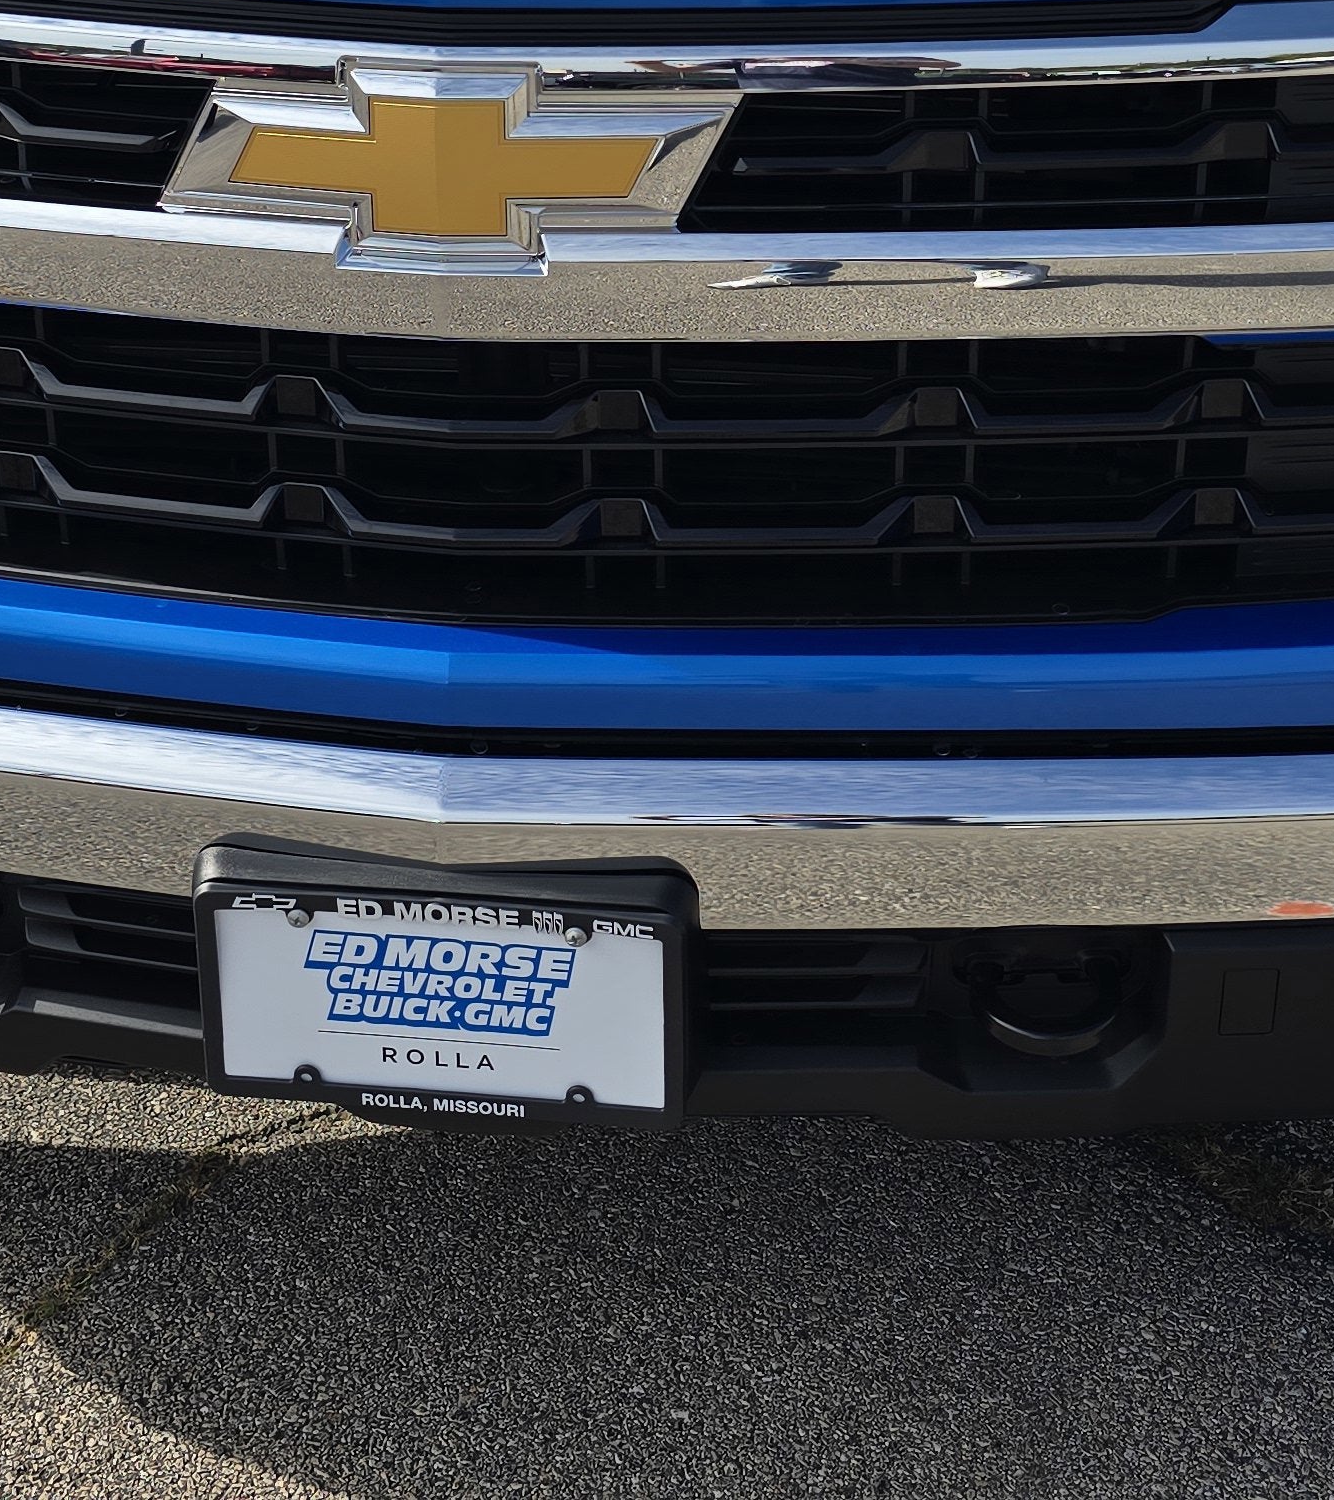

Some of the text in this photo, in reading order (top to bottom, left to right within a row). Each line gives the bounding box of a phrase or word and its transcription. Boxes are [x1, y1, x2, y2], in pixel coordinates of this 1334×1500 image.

[336, 898, 654, 939] ED MORSE GMC
[309, 933, 574, 980] ED MORSE
[329, 965, 553, 1004] CHEVROLET
[382, 1046, 495, 1072] ROLLA
[361, 1092, 525, 1118] ROLLA, MISSOURI
